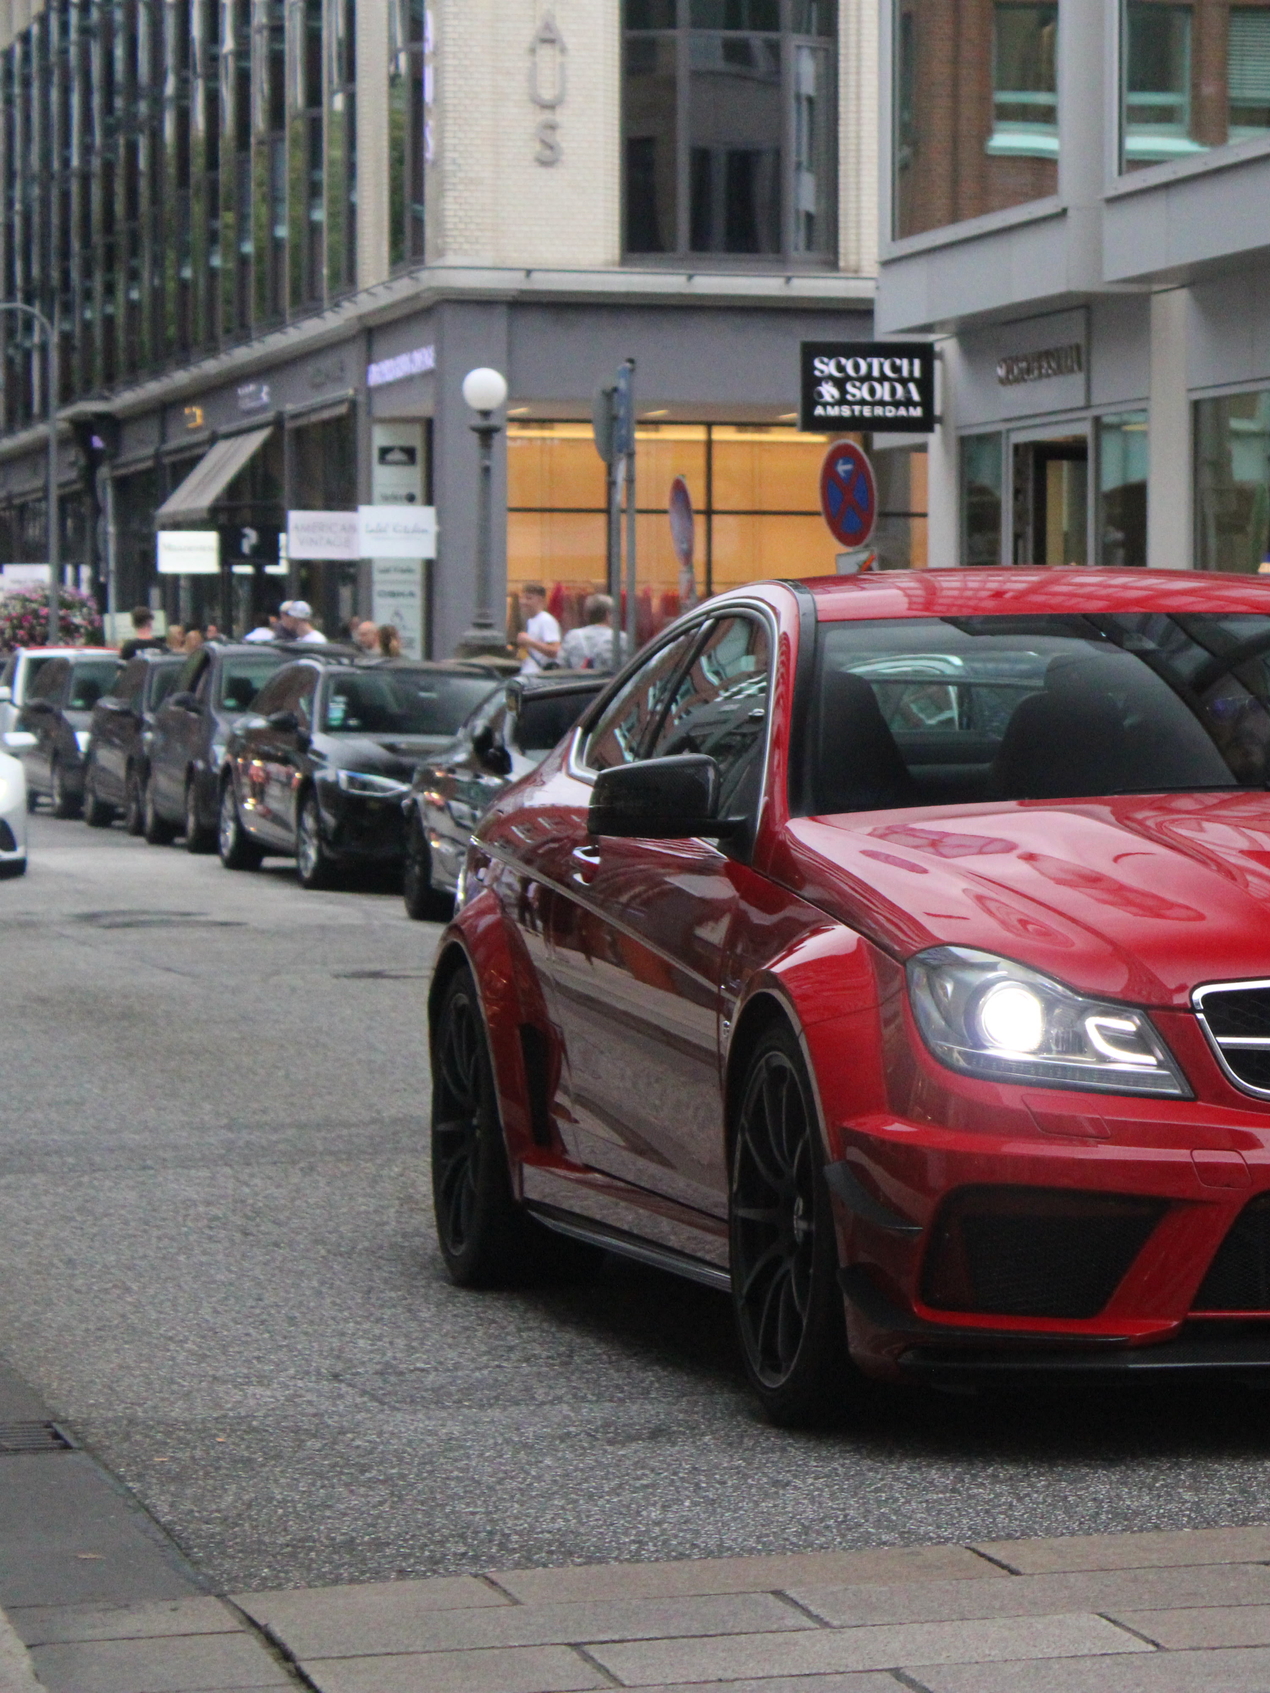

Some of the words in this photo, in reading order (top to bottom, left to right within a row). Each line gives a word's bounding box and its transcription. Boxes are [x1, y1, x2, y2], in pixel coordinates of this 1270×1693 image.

[813, 356, 921, 378] SCOTCH
[814, 380, 840, 402] &
[845, 381, 921, 402] SODA
[814, 405, 923, 417] AMSTERDAM
